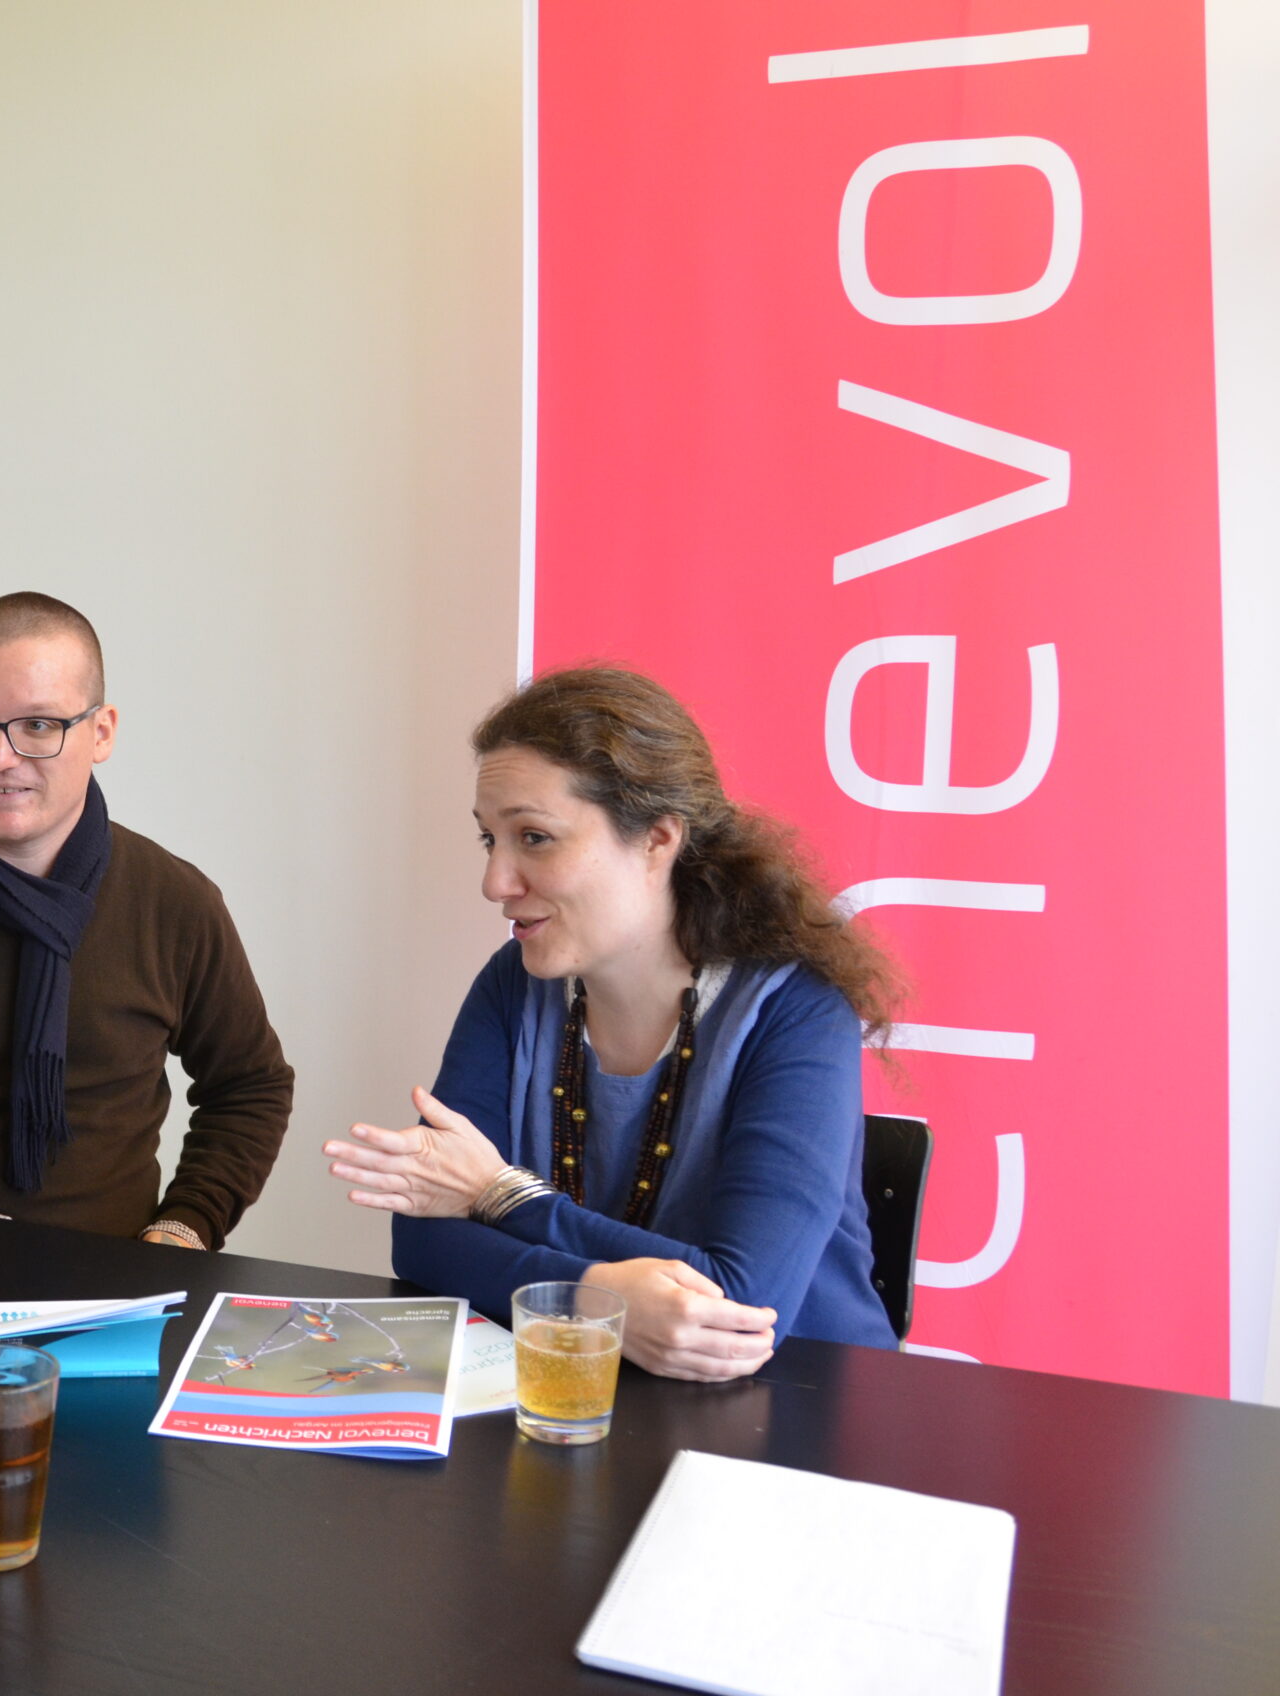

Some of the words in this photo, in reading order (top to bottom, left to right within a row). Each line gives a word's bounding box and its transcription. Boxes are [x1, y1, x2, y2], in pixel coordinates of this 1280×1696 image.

[766, 23, 1092, 1364] nevol
[233, 1299, 288, 1309] benevol
[380, 1314, 450, 1322] Gemeinsame
[204, 1423, 332, 1440] Nachrichten
[338, 1429, 429, 1442] benevol
